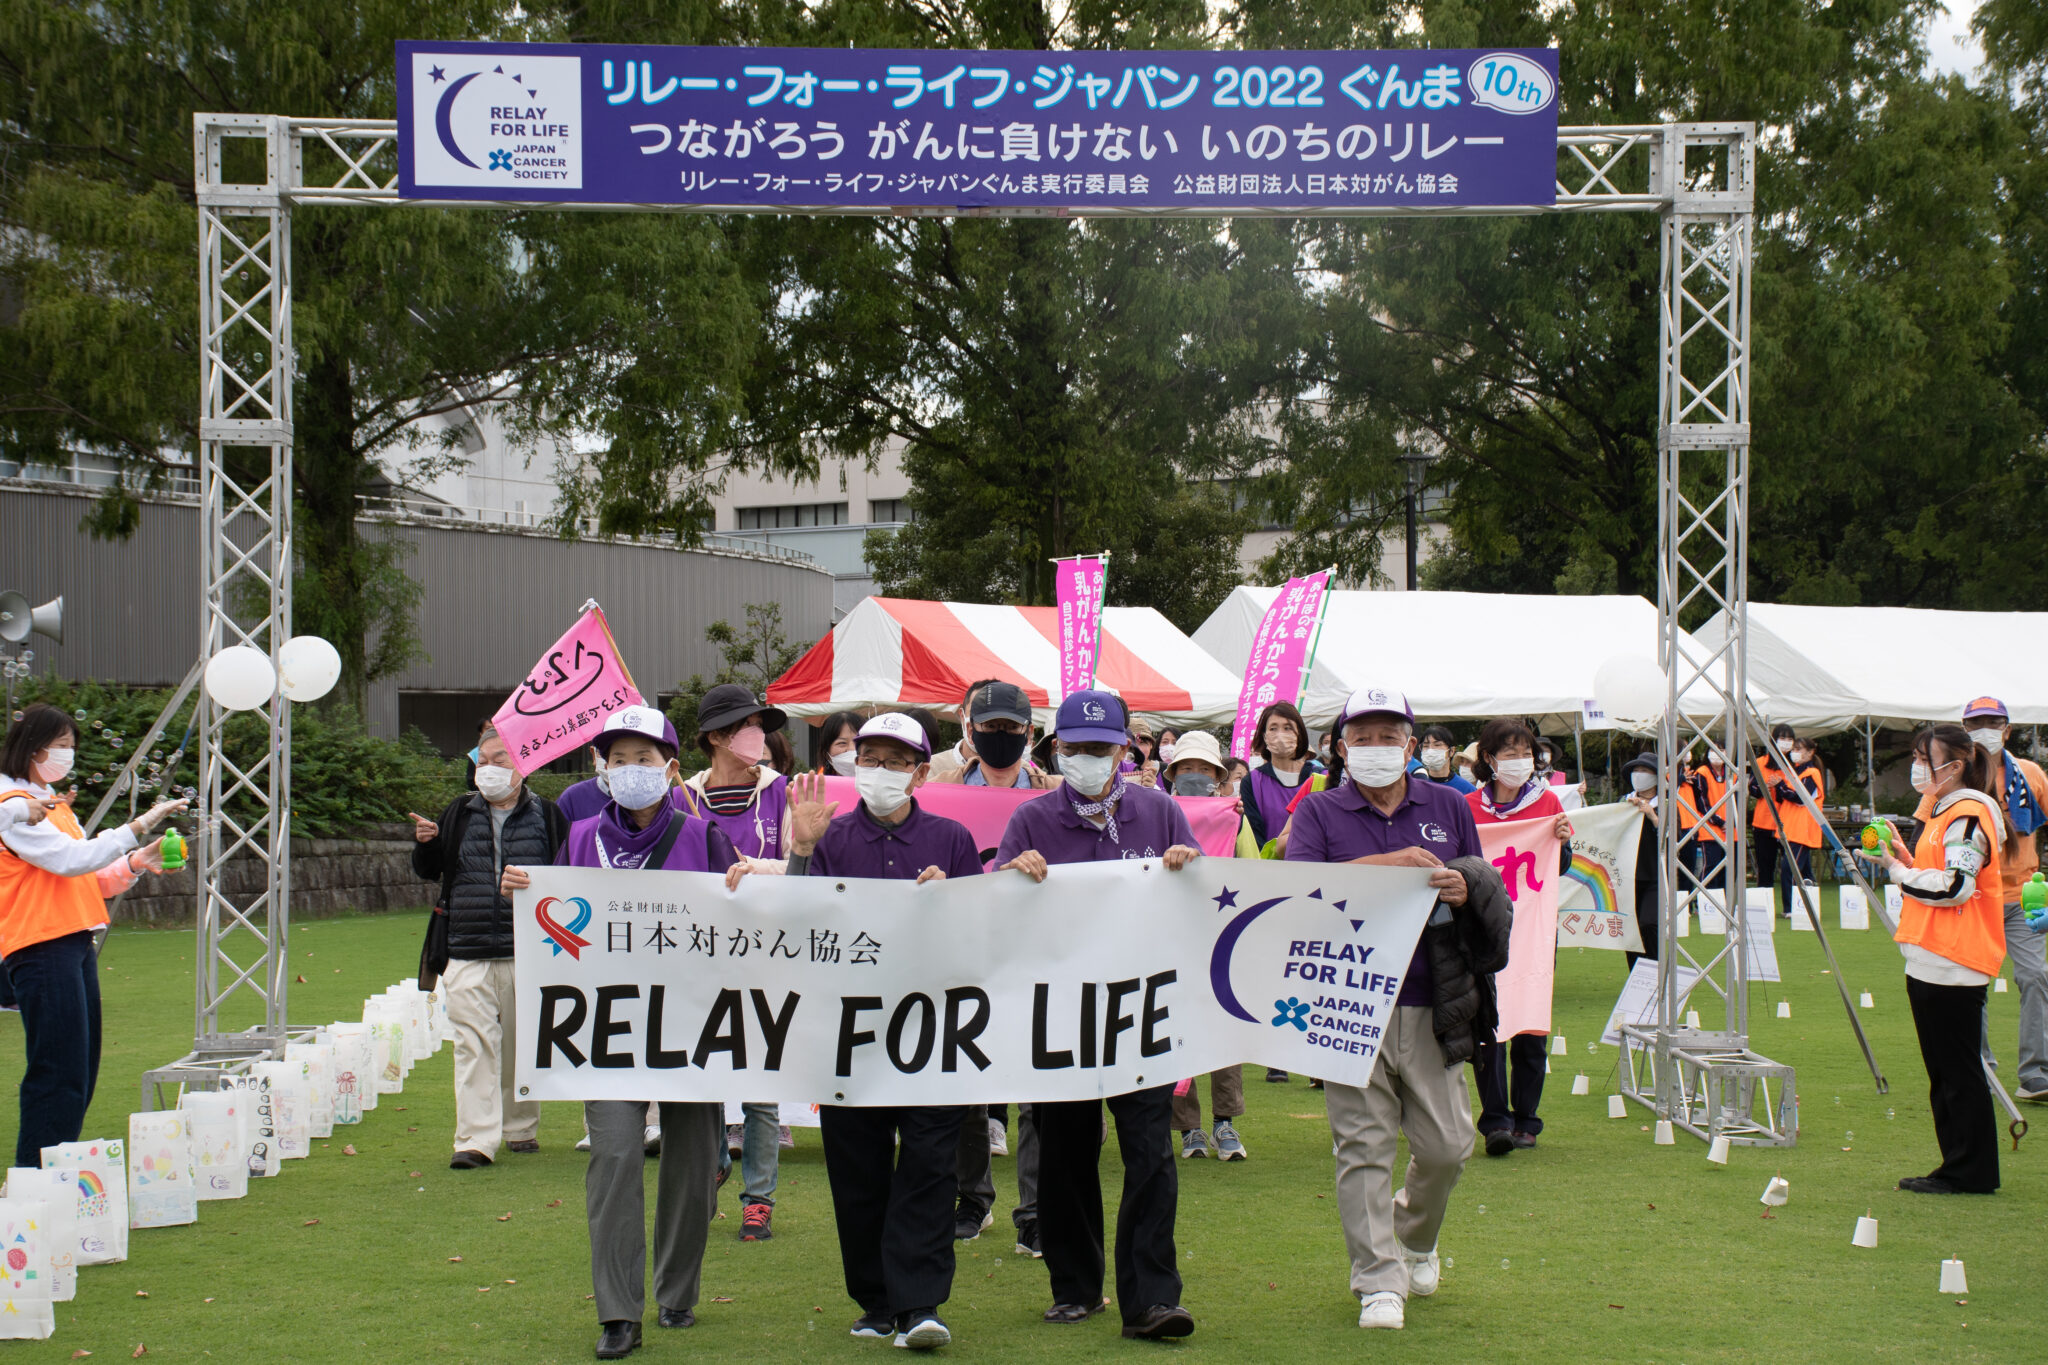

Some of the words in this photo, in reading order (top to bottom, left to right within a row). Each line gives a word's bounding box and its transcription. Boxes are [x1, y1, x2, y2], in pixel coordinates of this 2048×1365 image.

[1211, 64, 1325, 109] 2022
[1338, 63, 1463, 110] ぐんま
[1483, 61, 1542, 105] 10th
[491, 106, 547, 120] RELAY
[491, 123, 526, 136] FOR
[532, 124, 569, 137] LIFE
[629, 118, 845, 160] つながろう
[868, 119, 1178, 162] がんに負けない
[1202, 121, 1504, 162] いのちのリレー
[513, 144, 556, 153] JAPAN
[513, 158, 567, 167] CANCER
[513, 170, 568, 179] SOCIETY
[1173, 172, 1459, 196] 公益財団法人日本対がん協会
[1492, 846, 1544, 901] れ
[608, 900, 691, 915] 公益財団法人
[1562, 913, 1624, 938] ぐんま
[607, 920, 883, 966] 日本対がん協会
[1288, 940, 1375, 965] RELAY
[1283, 961, 1337, 985] FOR
[1345, 968, 1399, 996] LIFE
[1312, 995, 1375, 1018] JAPAN
[535, 984, 801, 1071] RELAY
[835, 986, 992, 1077] FOR
[1031, 969, 1177, 1070] LIFE
[1309, 1013, 1381, 1039] CANCER
[1306, 1031, 1377, 1058] SOCIETY
